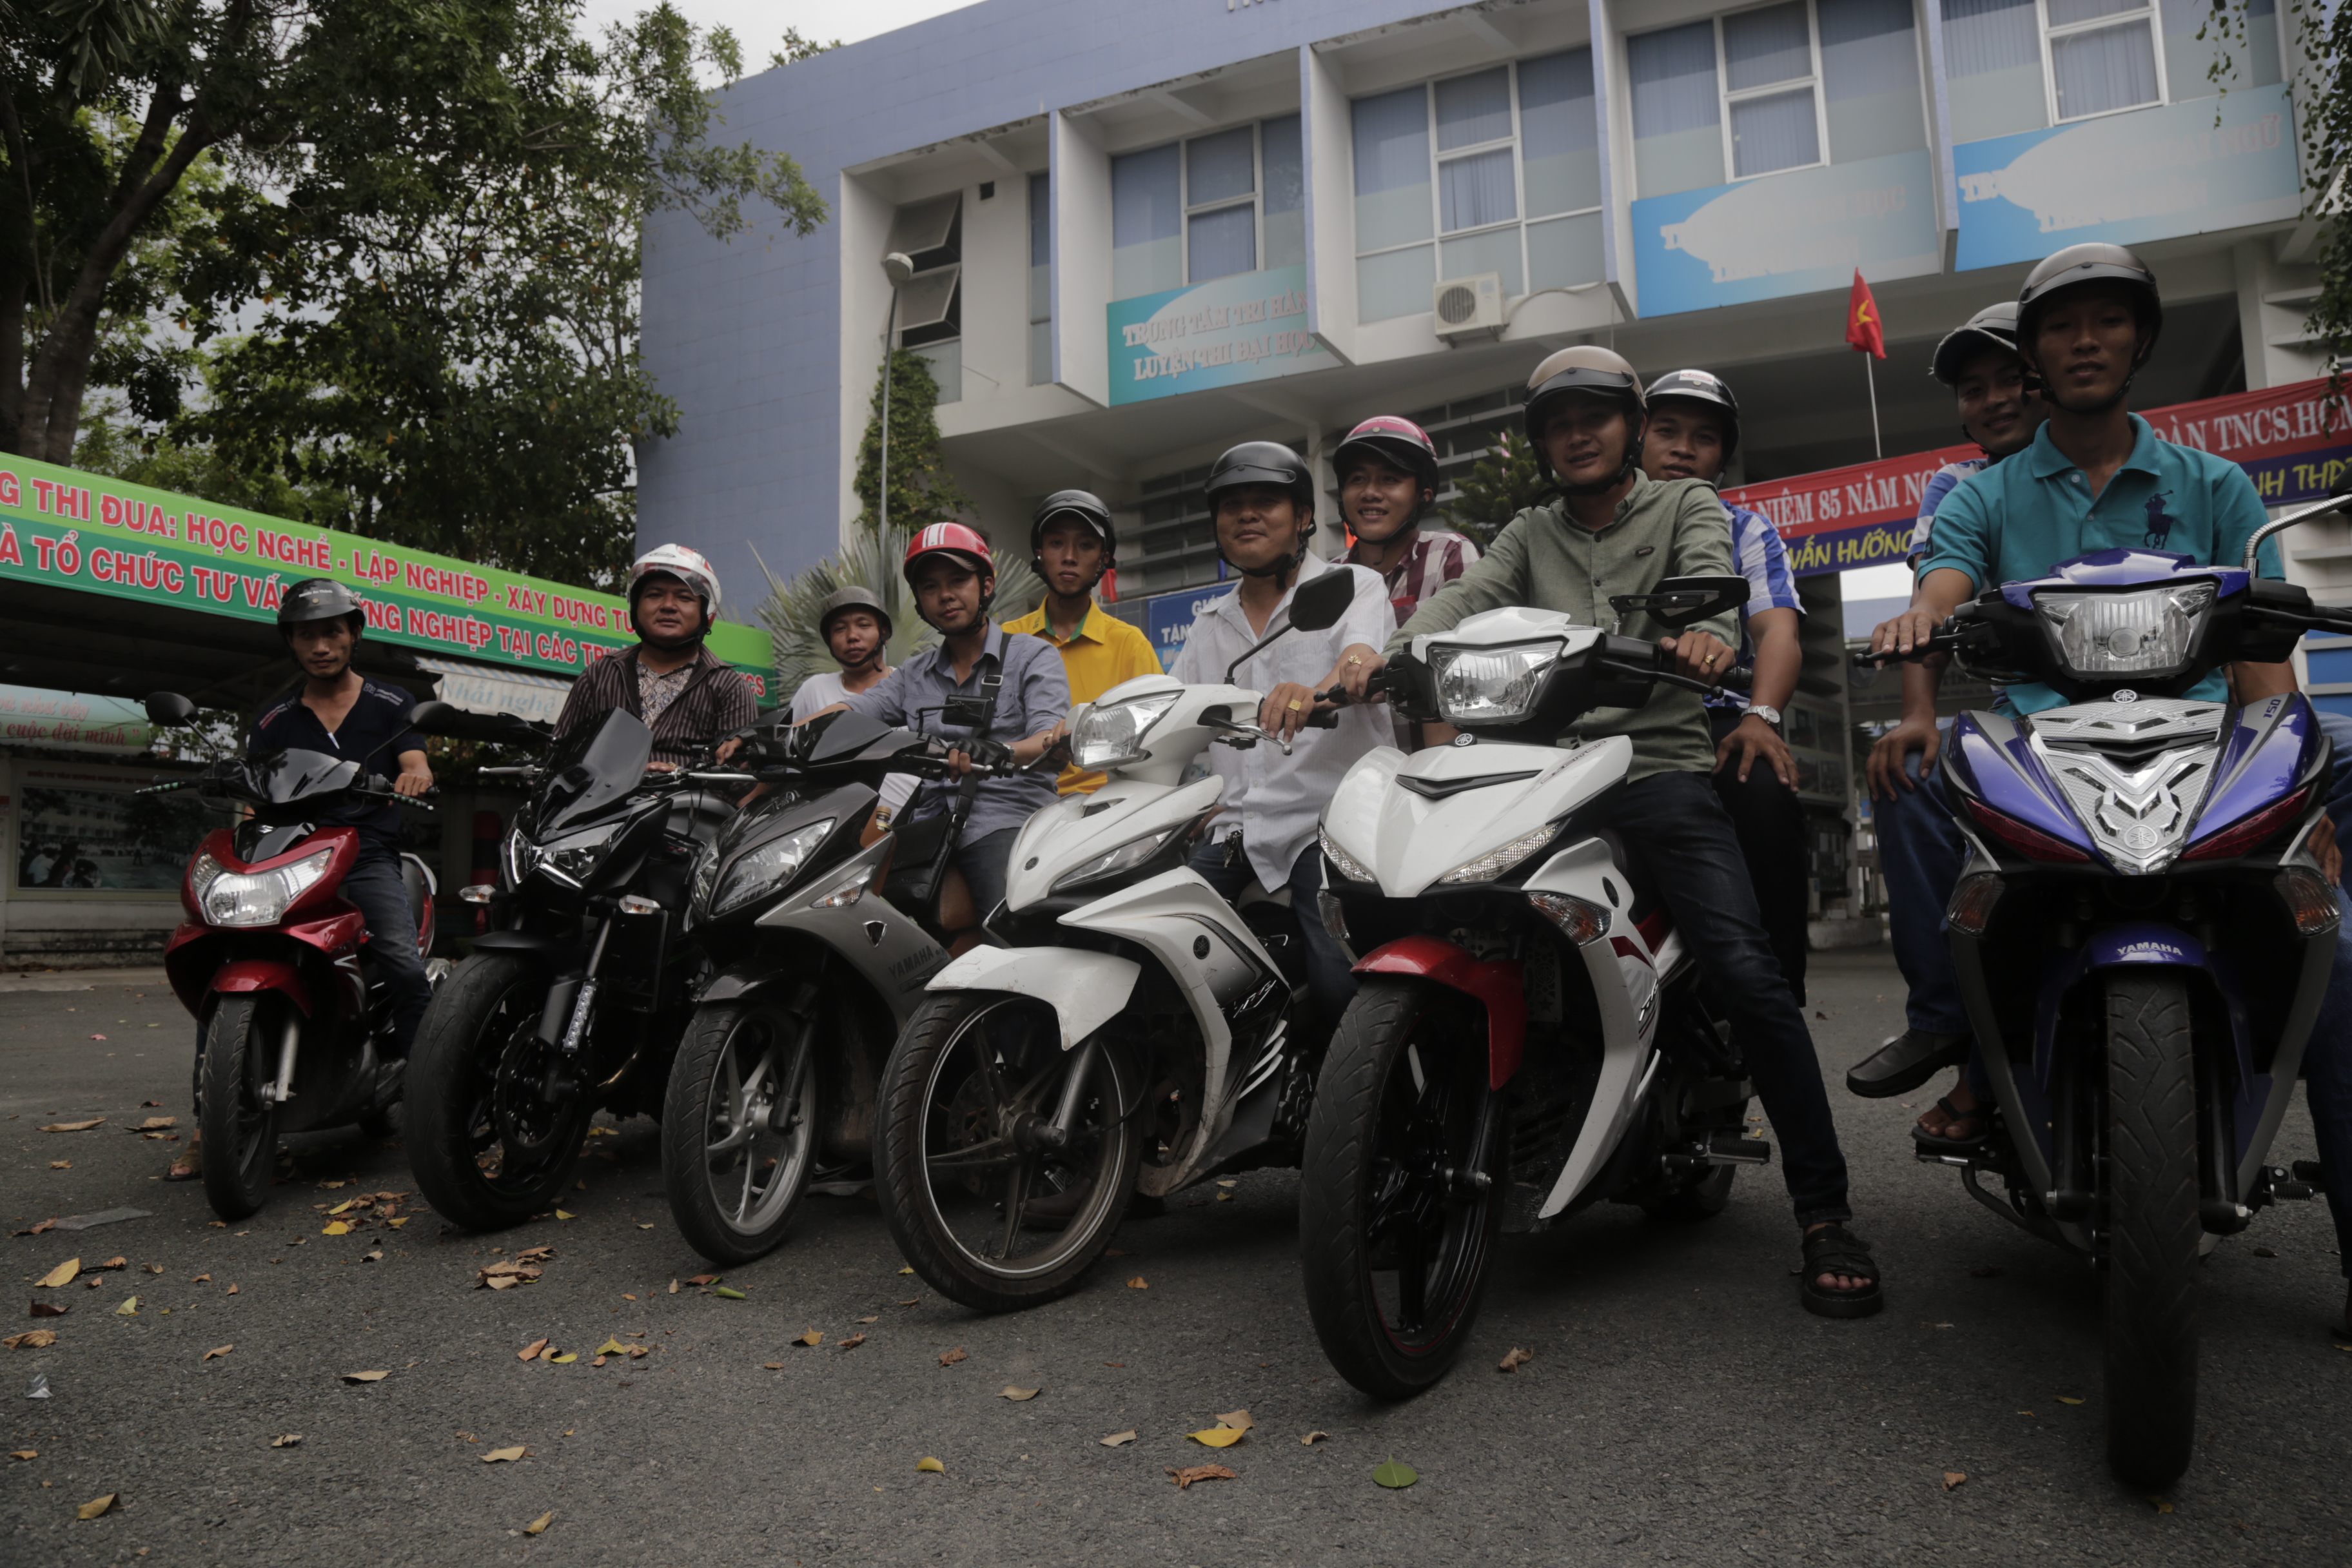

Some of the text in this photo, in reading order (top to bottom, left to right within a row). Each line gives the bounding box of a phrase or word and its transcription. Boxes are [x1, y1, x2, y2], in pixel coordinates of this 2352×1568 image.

[1122, 314, 1186, 347] TRUNG
[1189, 304, 1230, 335] TÂM
[1233, 299, 1267, 324] TRI
[1133, 327, 1317, 381] LUYỆN THI ĐẠI HỌC
[1819, 487, 1841, 520] 85
[1846, 472, 1899, 516] NĂM
[30, 476, 91, 522] THI
[99, 492, 177, 540] ĐUA:
[185, 511, 250, 556] HỌC
[255, 527, 333, 572] NGHỀ
[353, 549, 400, 587] LẬP
[404, 560, 490, 606] NGHIỆP
[505, 583, 547, 617] XÂY
[551, 594, 608, 629] DỰNG
[32, 529, 81, 576] TỔ
[89, 547, 184, 594] CHỨC
[191, 565, 239, 603] TƯ
[407, 606, 493, 652] NGHIỆP
[496, 624, 532, 661] TẠI
[536, 631, 578, 665] CÁC
[20, 694, 58, 715] như
[60, 698, 90, 721] vậy
[500, 693, 556, 718] nghệ
[2262, 699, 2282, 718] 150
[6, 720, 48, 742] cuộc
[52, 721, 81, 741] đời
[84, 726, 126, 745] mình
[888, 945, 934, 979] YAMAHA
[2117, 941, 2183, 956] YAMAHA
